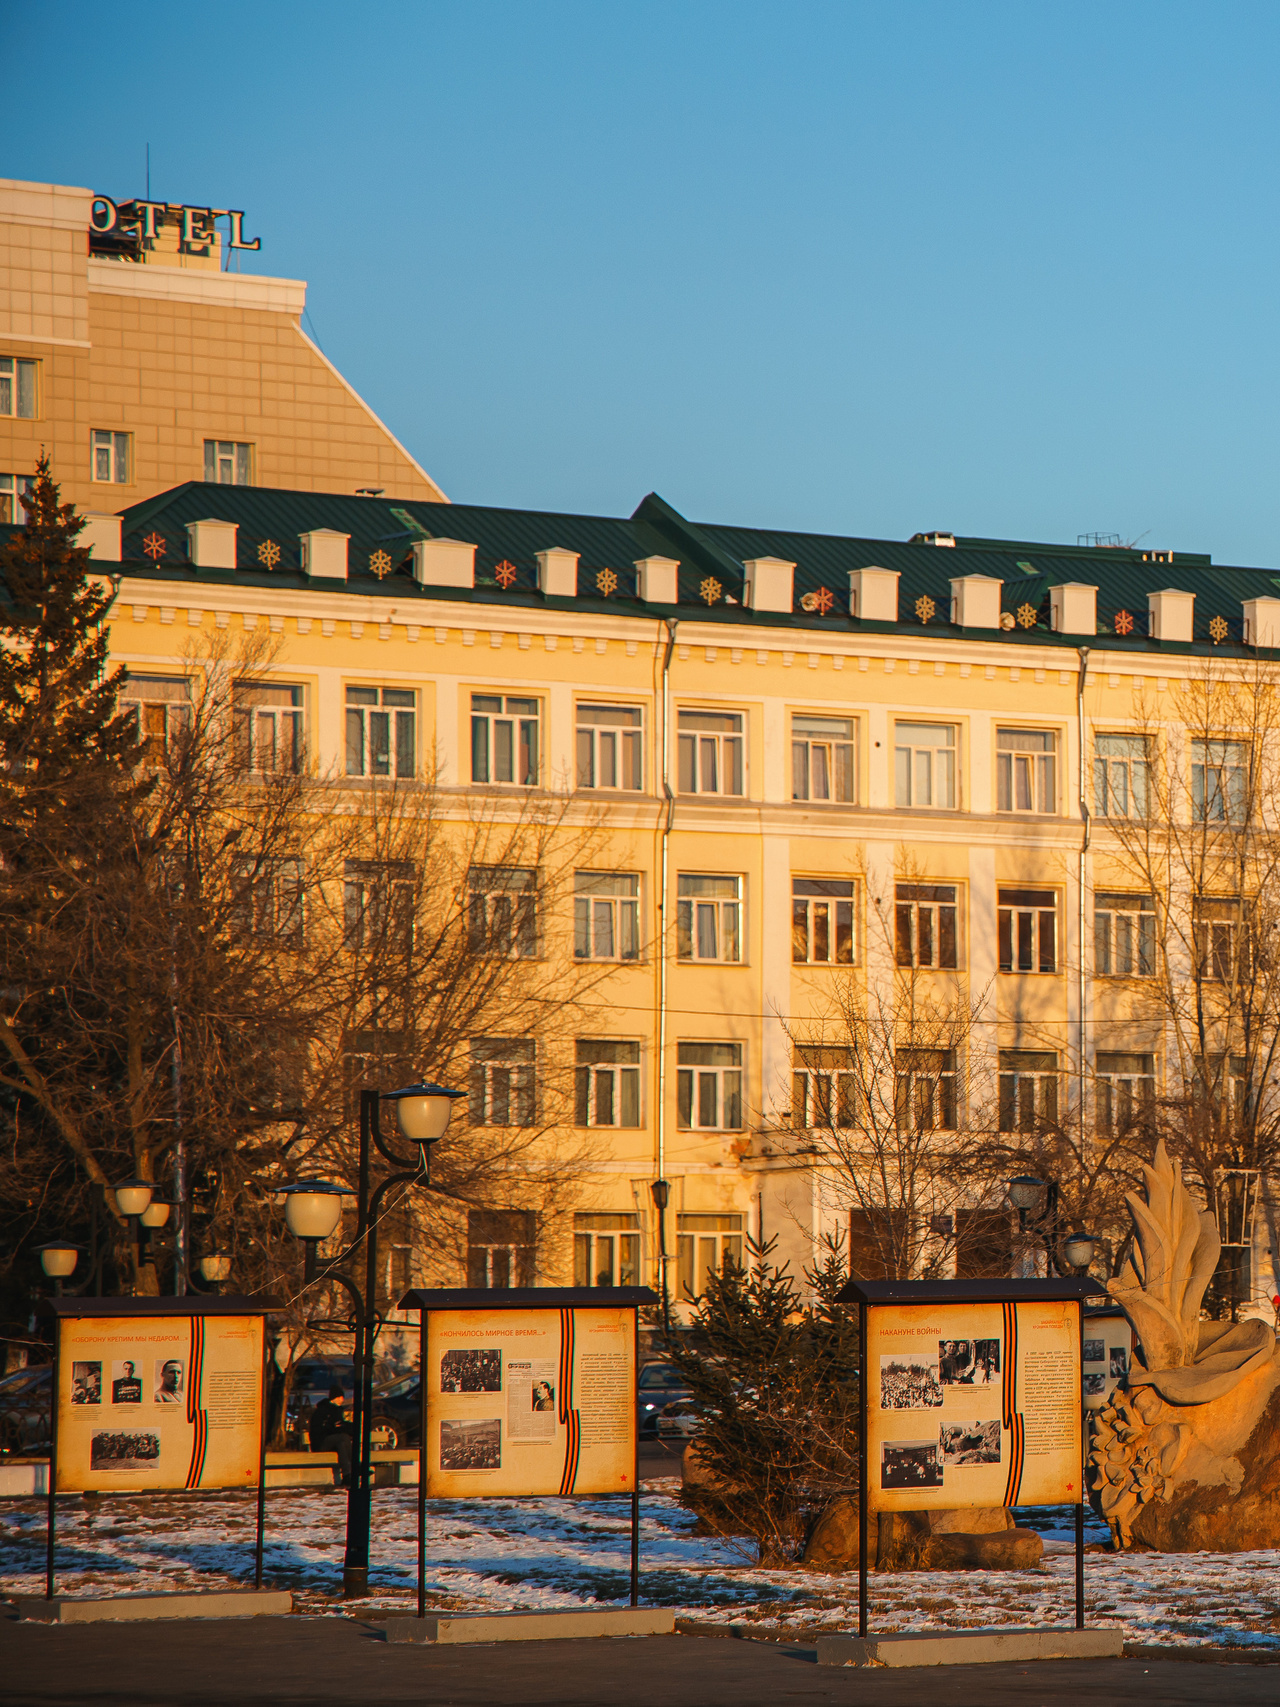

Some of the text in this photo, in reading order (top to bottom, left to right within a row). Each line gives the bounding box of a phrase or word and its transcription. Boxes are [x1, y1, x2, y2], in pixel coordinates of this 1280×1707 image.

[485, 1329, 514, 1337] МИРНОЕ
[879, 1327, 942, 1336] НАКАНУНЕ ВОЙНЫ
